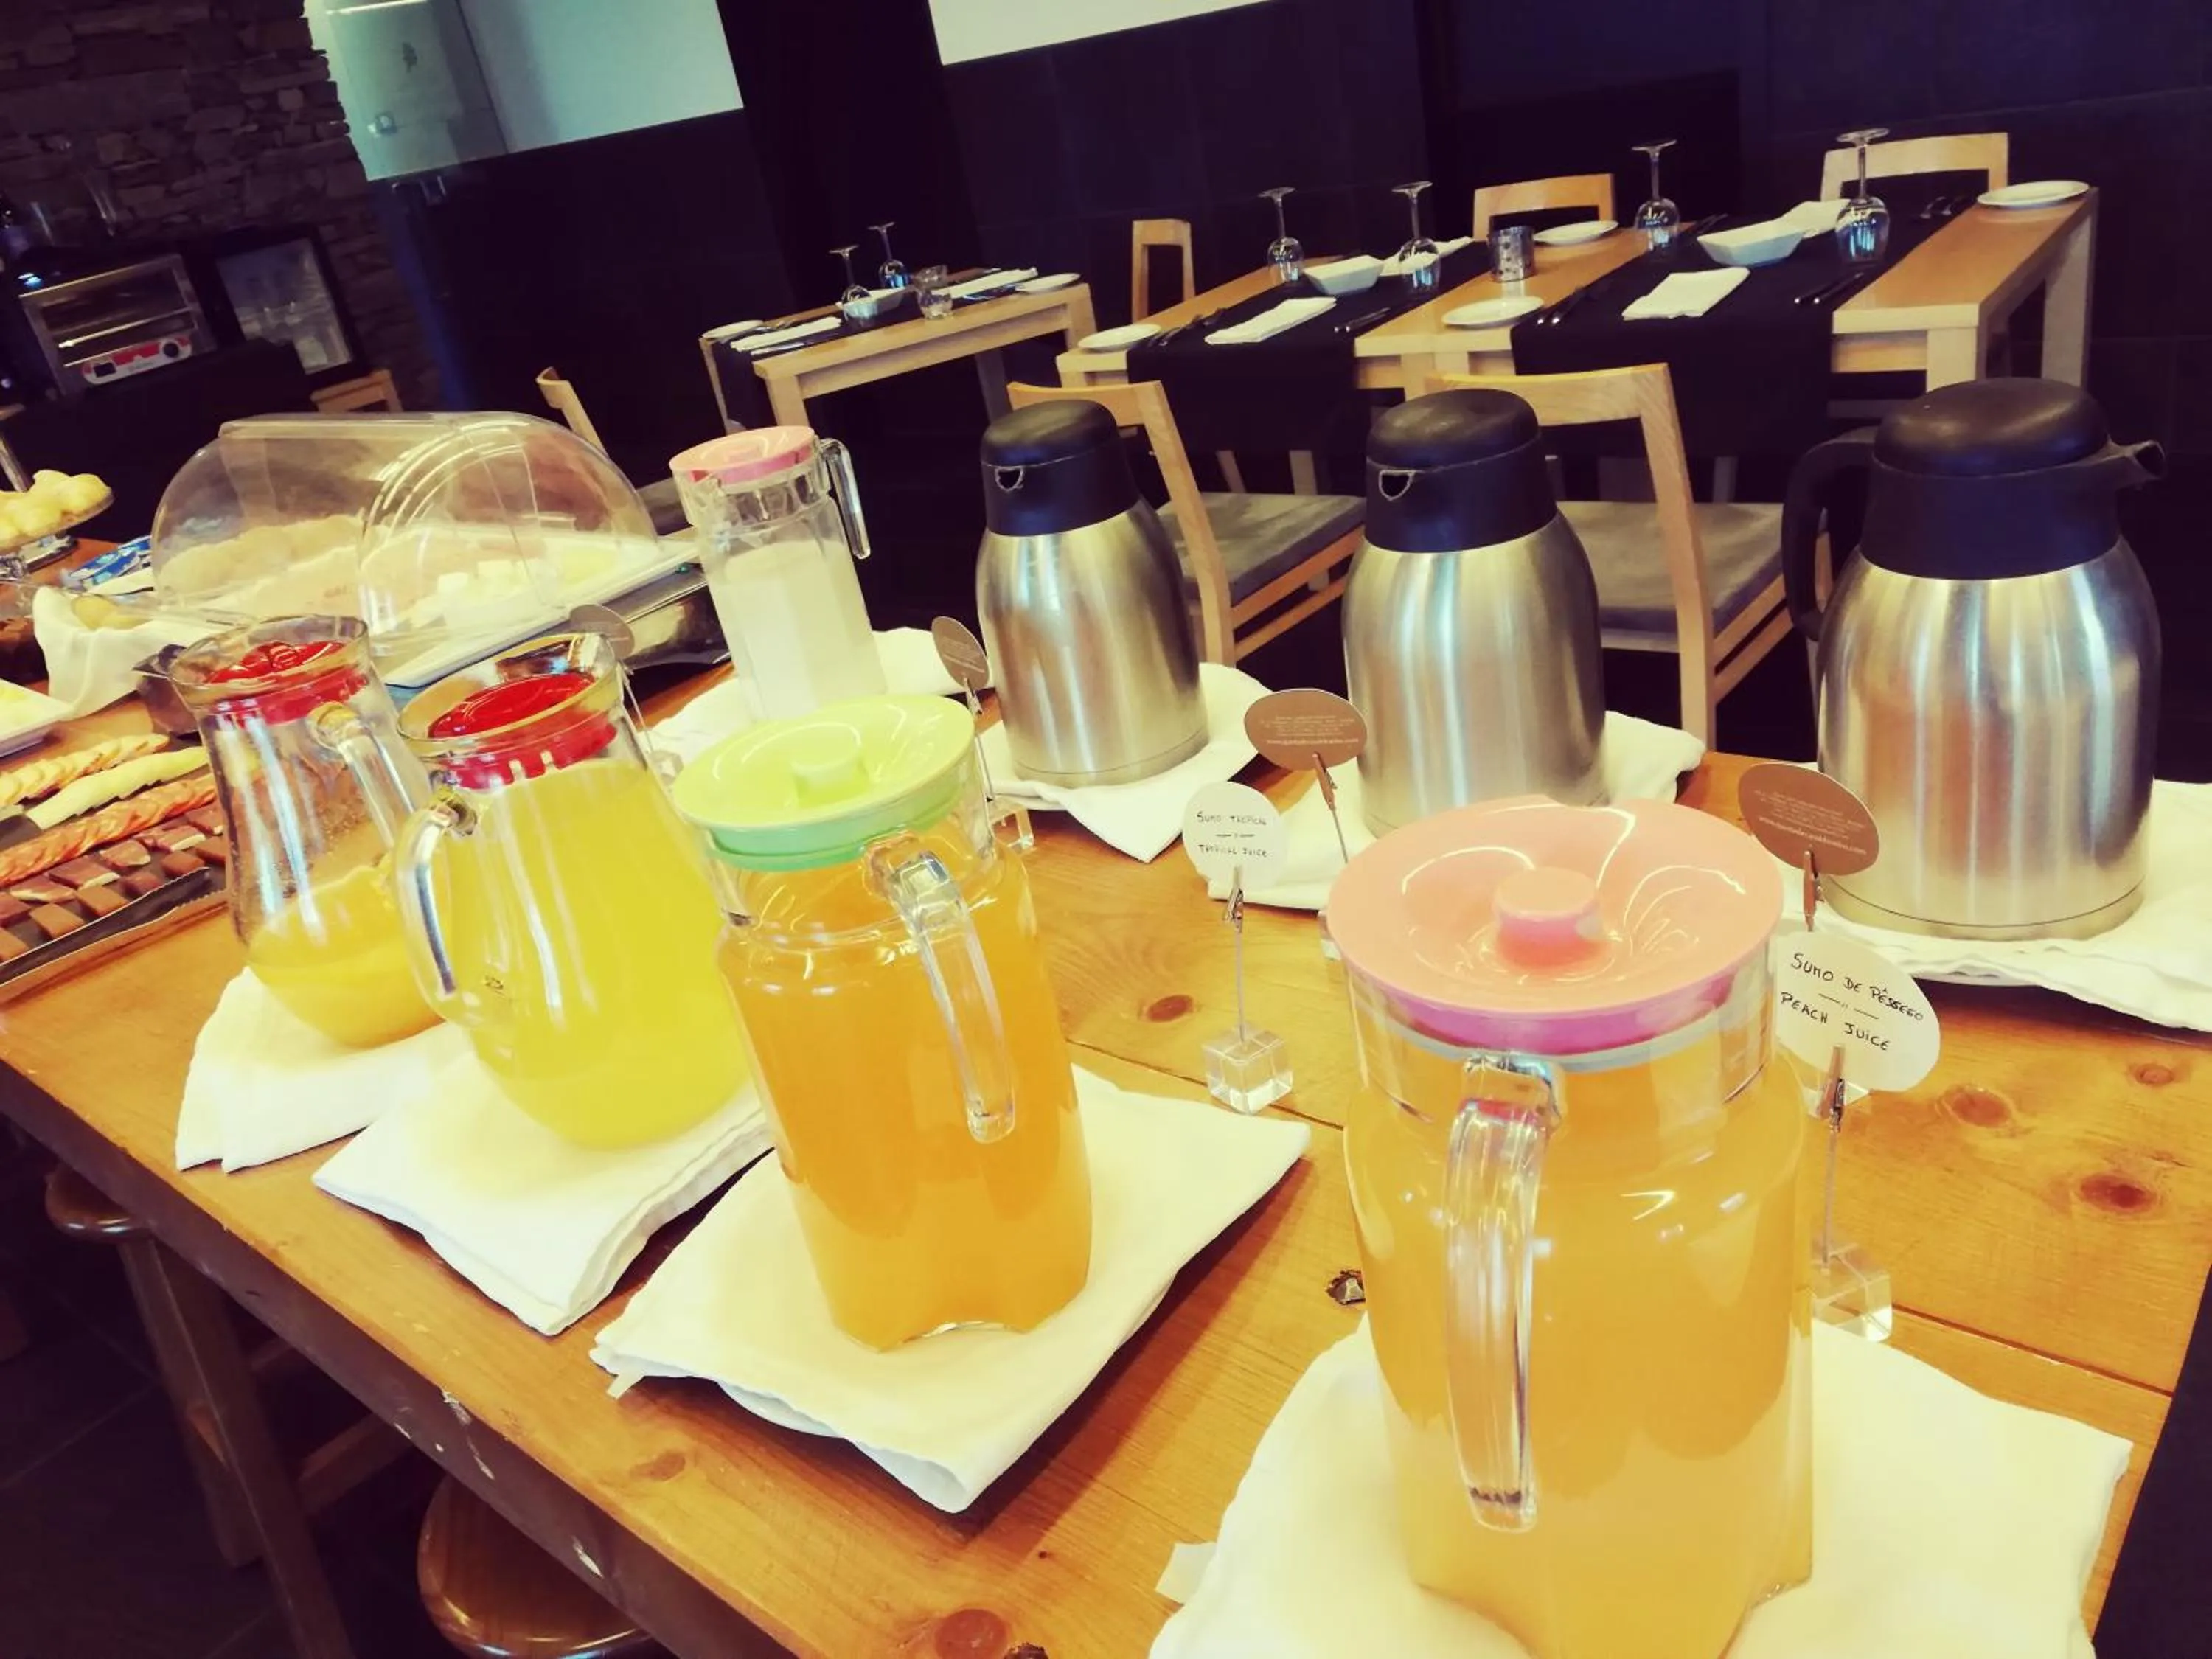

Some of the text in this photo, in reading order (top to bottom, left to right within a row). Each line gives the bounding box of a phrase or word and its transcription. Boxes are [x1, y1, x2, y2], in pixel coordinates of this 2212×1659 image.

[1791, 953, 1834, 981] SUMO
[1844, 977, 1863, 992] DE
[1781, 992, 1828, 1024] PEACH
